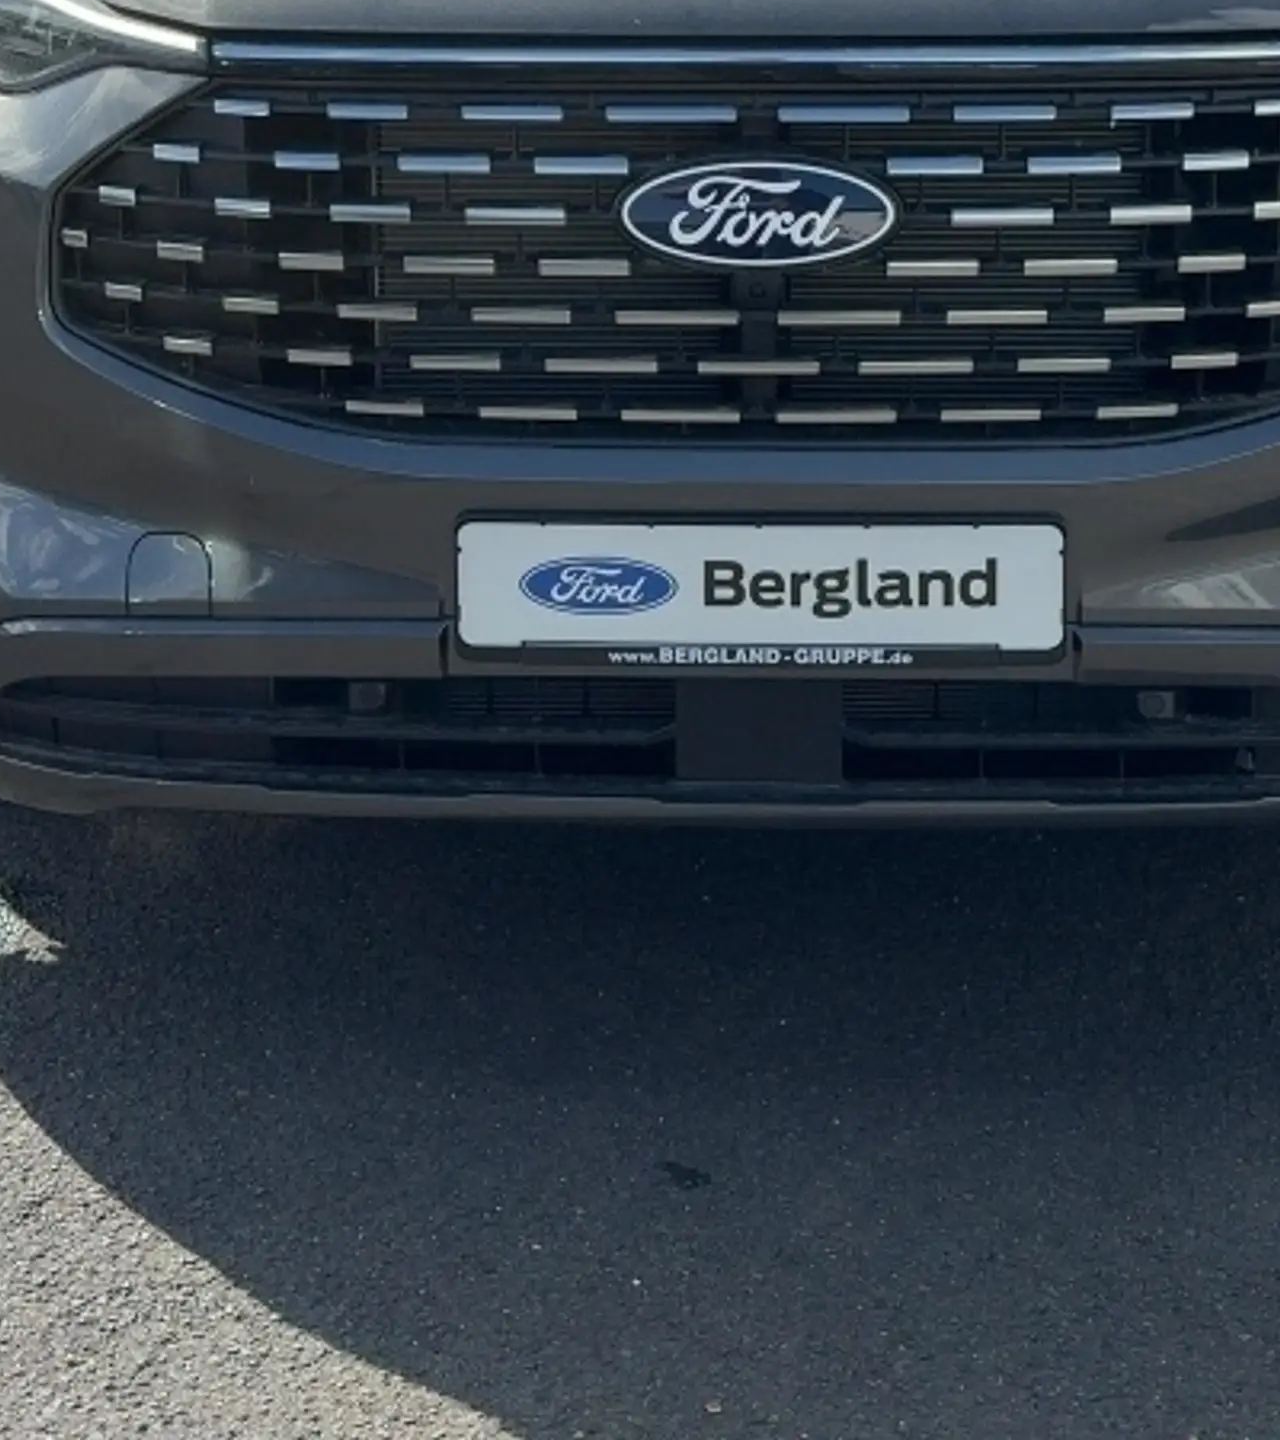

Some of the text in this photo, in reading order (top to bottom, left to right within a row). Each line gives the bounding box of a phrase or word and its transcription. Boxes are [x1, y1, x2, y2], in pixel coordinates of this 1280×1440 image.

[671, 176, 845, 246] Ford
[550, 559, 998, 618] Ford Bergland
[608, 647, 914, 664] www.BERGLAND-GRUPPE.de
